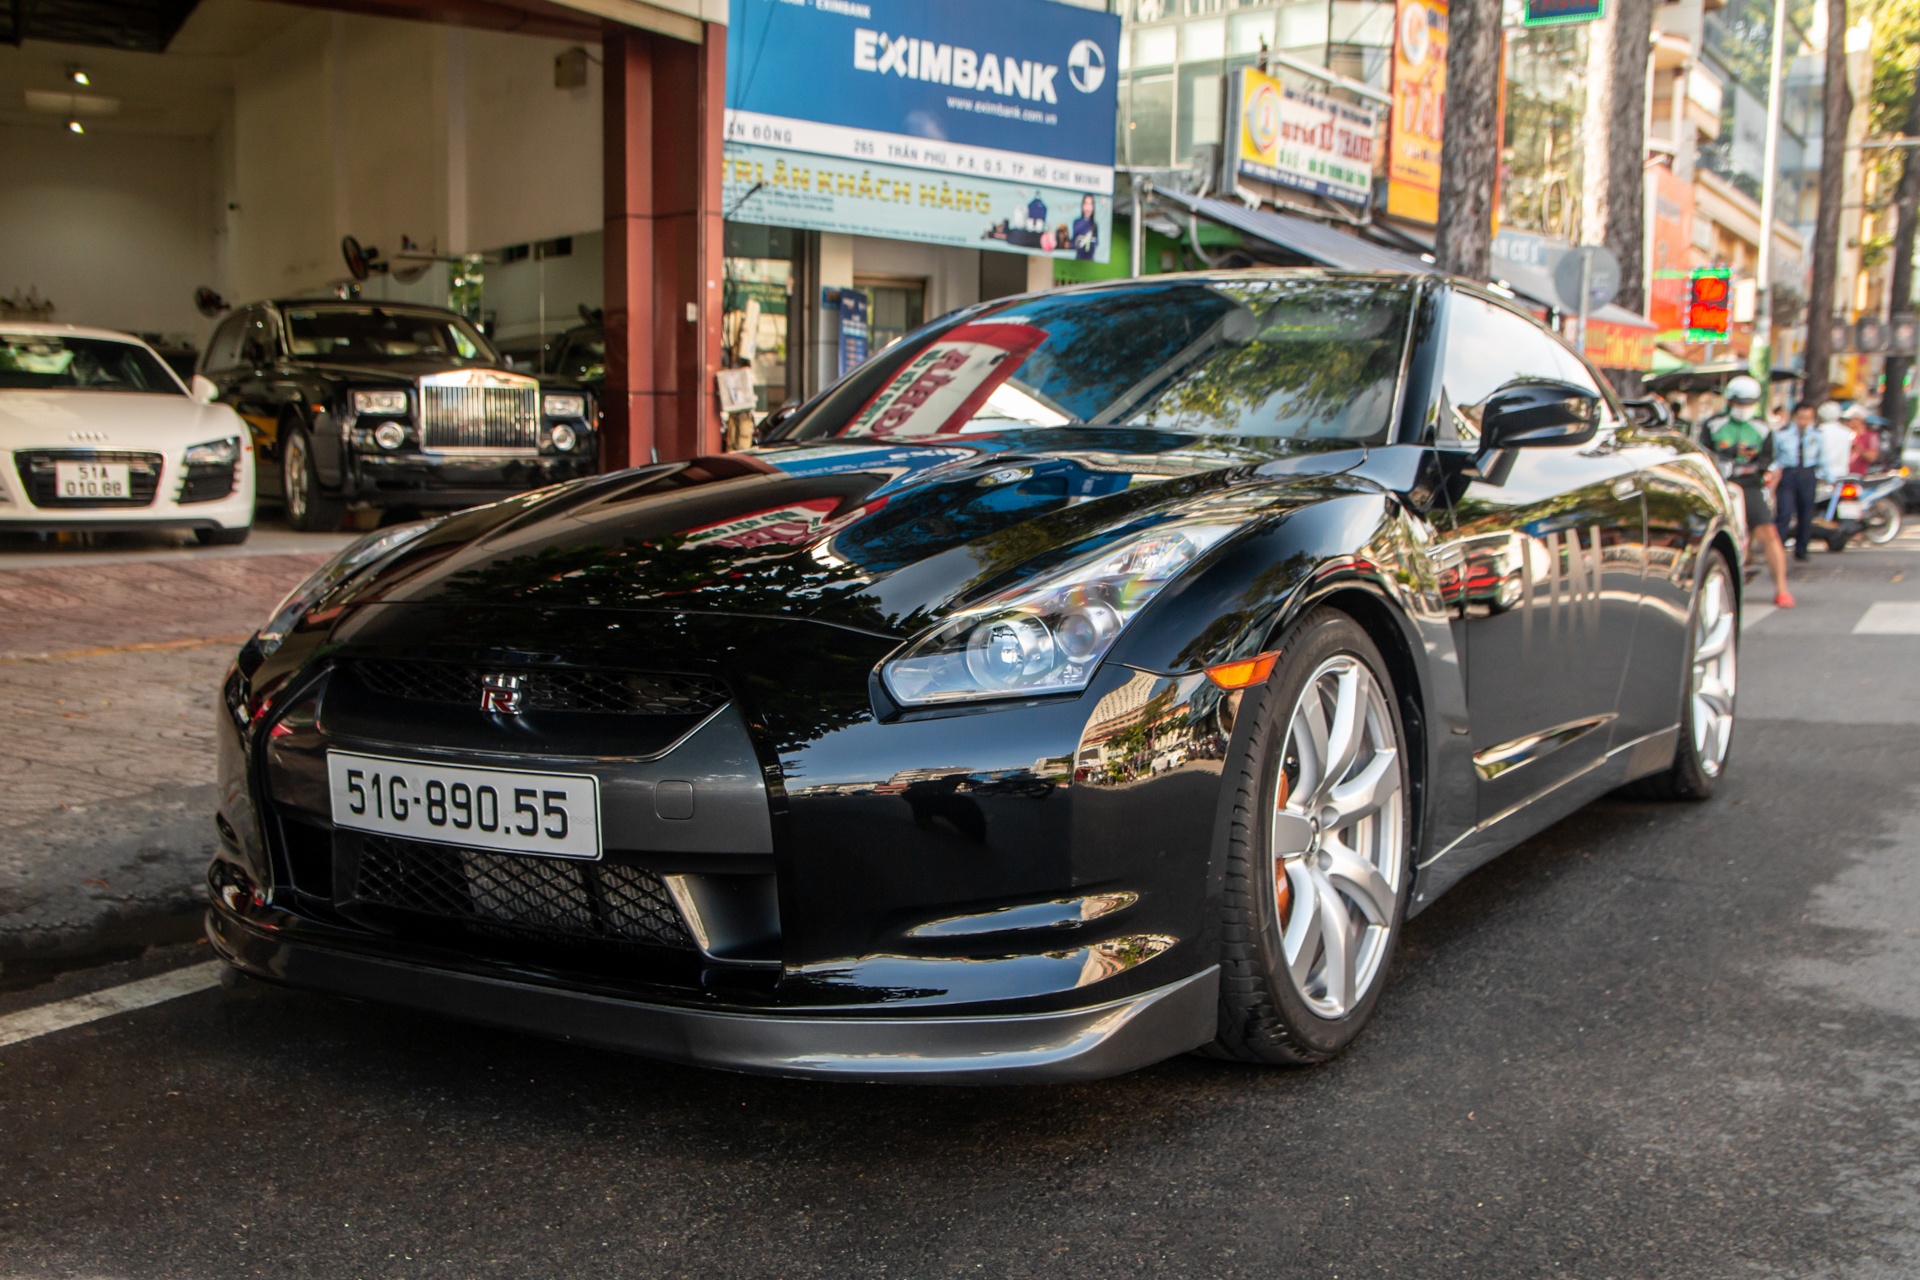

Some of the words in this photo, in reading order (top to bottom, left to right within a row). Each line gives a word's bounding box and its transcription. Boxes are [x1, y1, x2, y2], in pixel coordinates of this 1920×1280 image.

[853, 27, 1059, 104] EXIMBANK
[946, 96, 1058, 126] www.eximbank.com.vn
[772, 159, 810, 192] ÂN
[817, 169, 911, 205] KHÁCH
[919, 180, 991, 214] HÀNG
[346, 768, 570, 840] 51G-890.55
